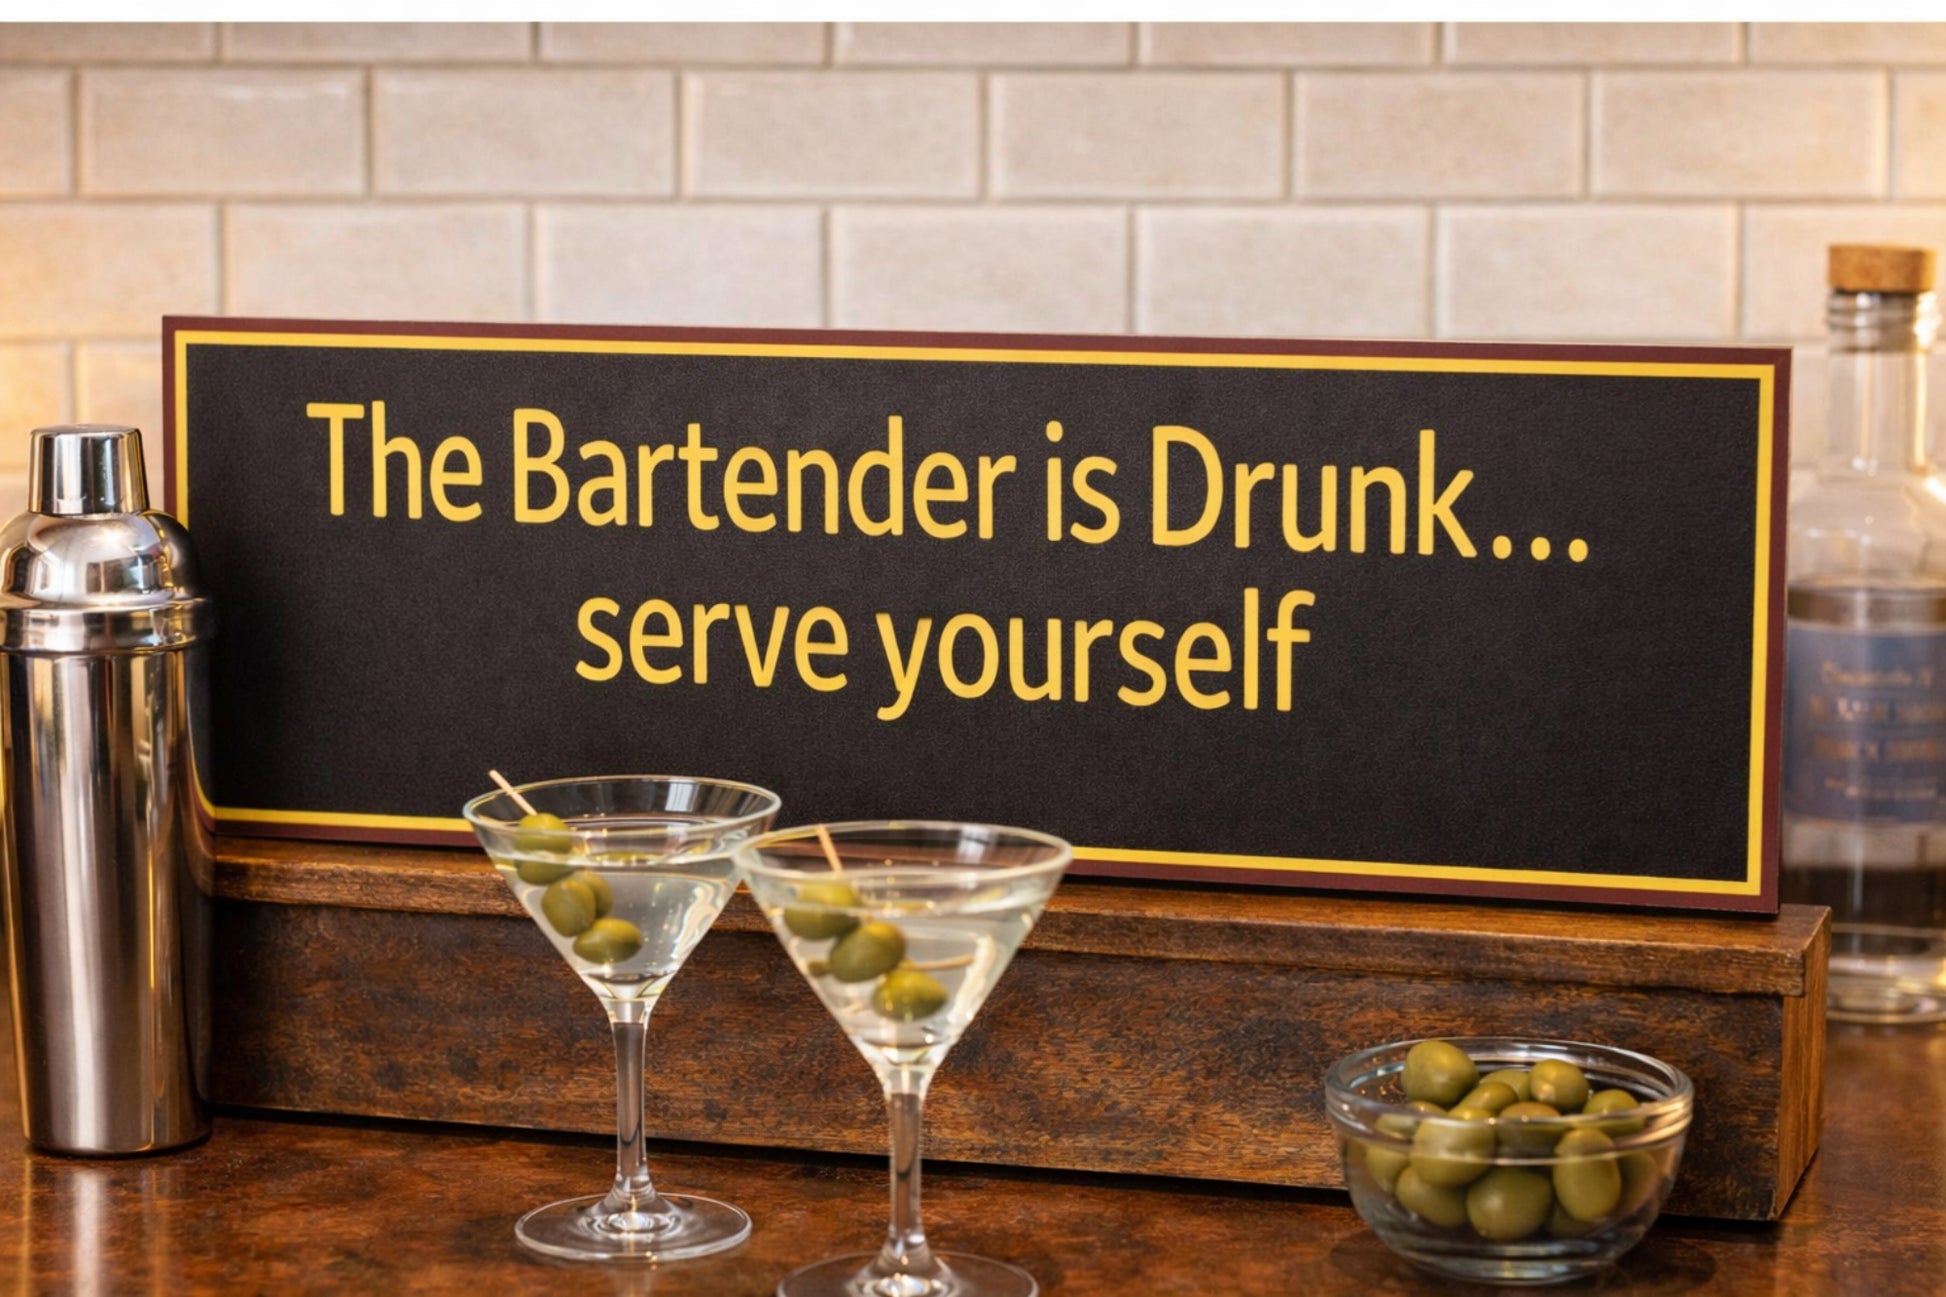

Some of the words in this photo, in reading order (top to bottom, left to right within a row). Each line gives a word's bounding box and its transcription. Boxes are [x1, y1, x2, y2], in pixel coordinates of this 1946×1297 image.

[305, 400, 484, 524] The
[511, 406, 1018, 541] Bartender
[1044, 419, 1122, 547] is
[1151, 424, 1590, 564] Drunk...
[574, 596, 850, 693] serve
[874, 586, 1317, 722] yourself
